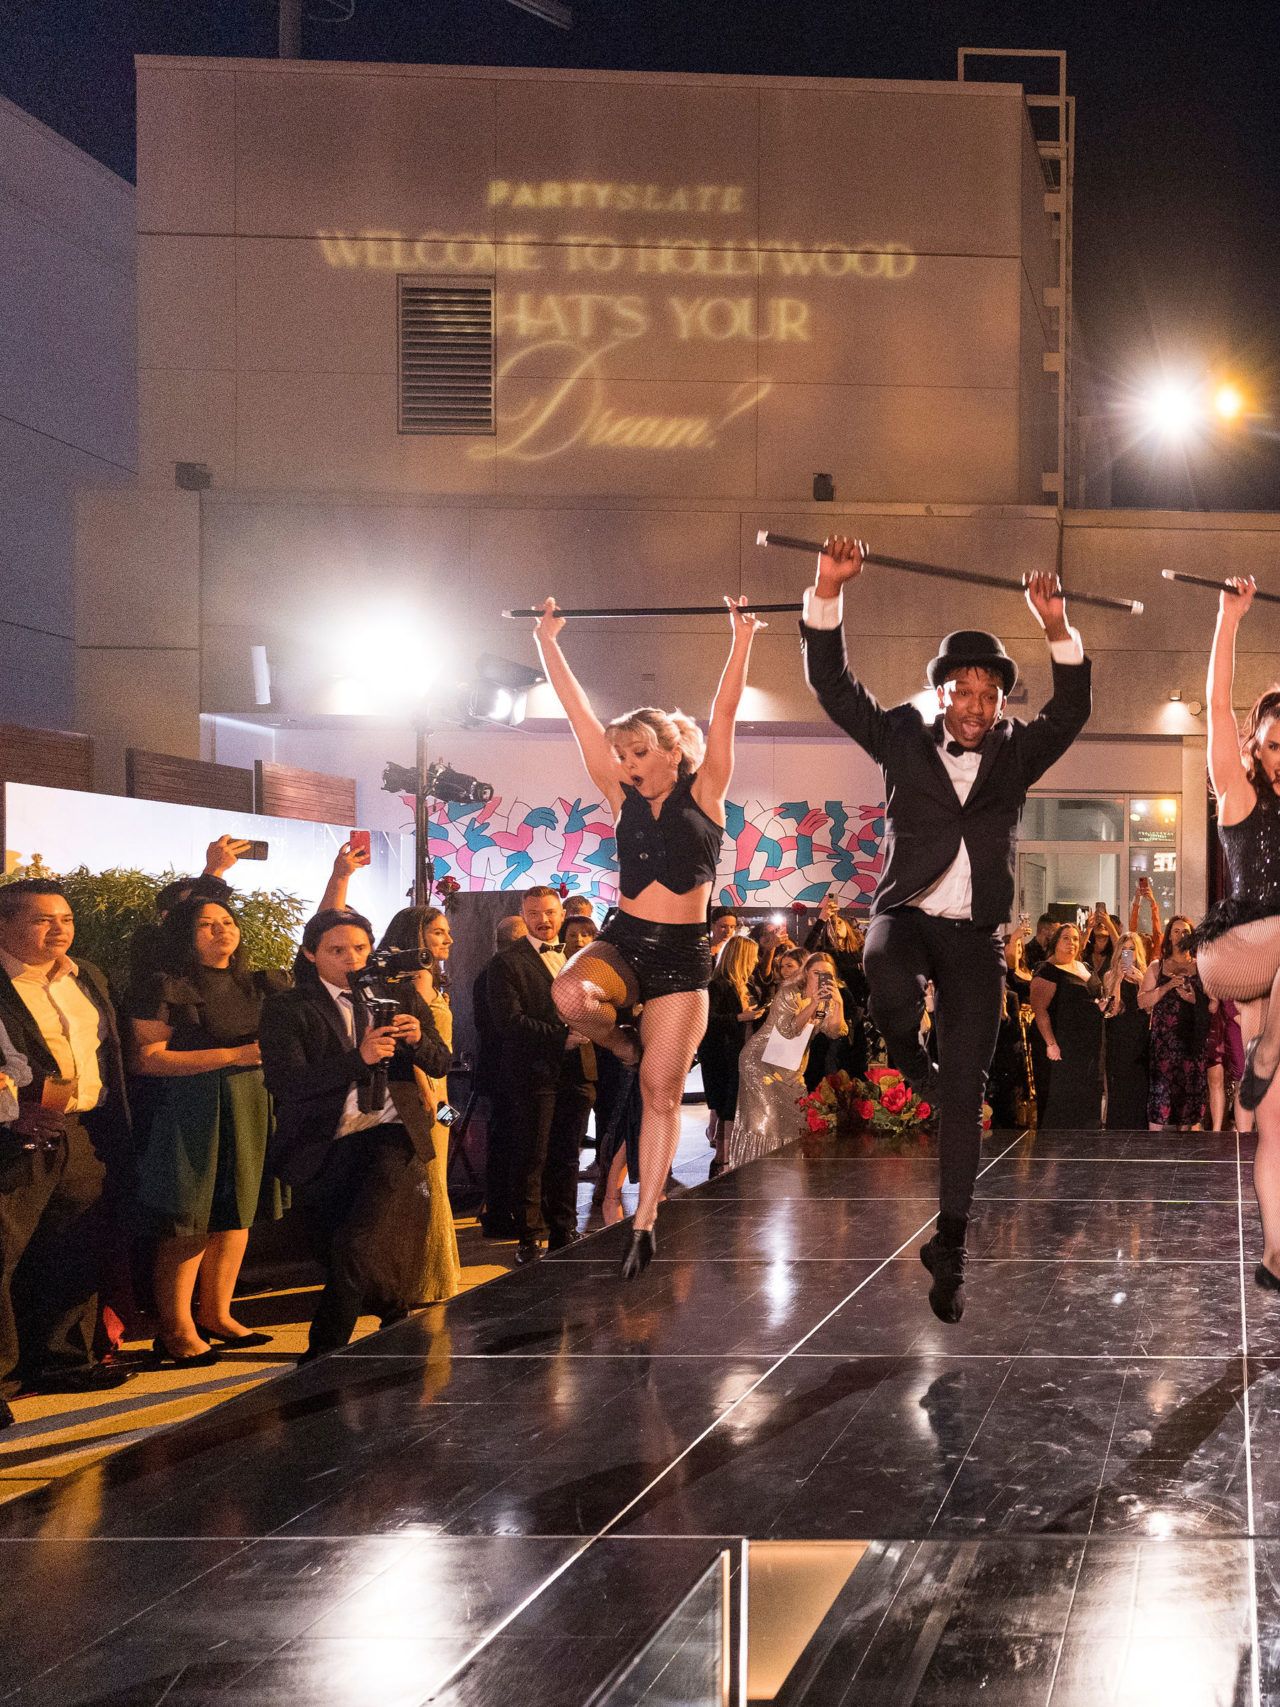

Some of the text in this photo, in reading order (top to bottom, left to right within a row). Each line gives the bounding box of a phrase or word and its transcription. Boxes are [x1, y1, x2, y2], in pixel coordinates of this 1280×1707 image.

[487, 179, 744, 212] PARTYSLATE
[317, 229, 917, 280] WELCOME TO HOLLYWOOD
[425, 294, 811, 342] HAT'S YOUR
